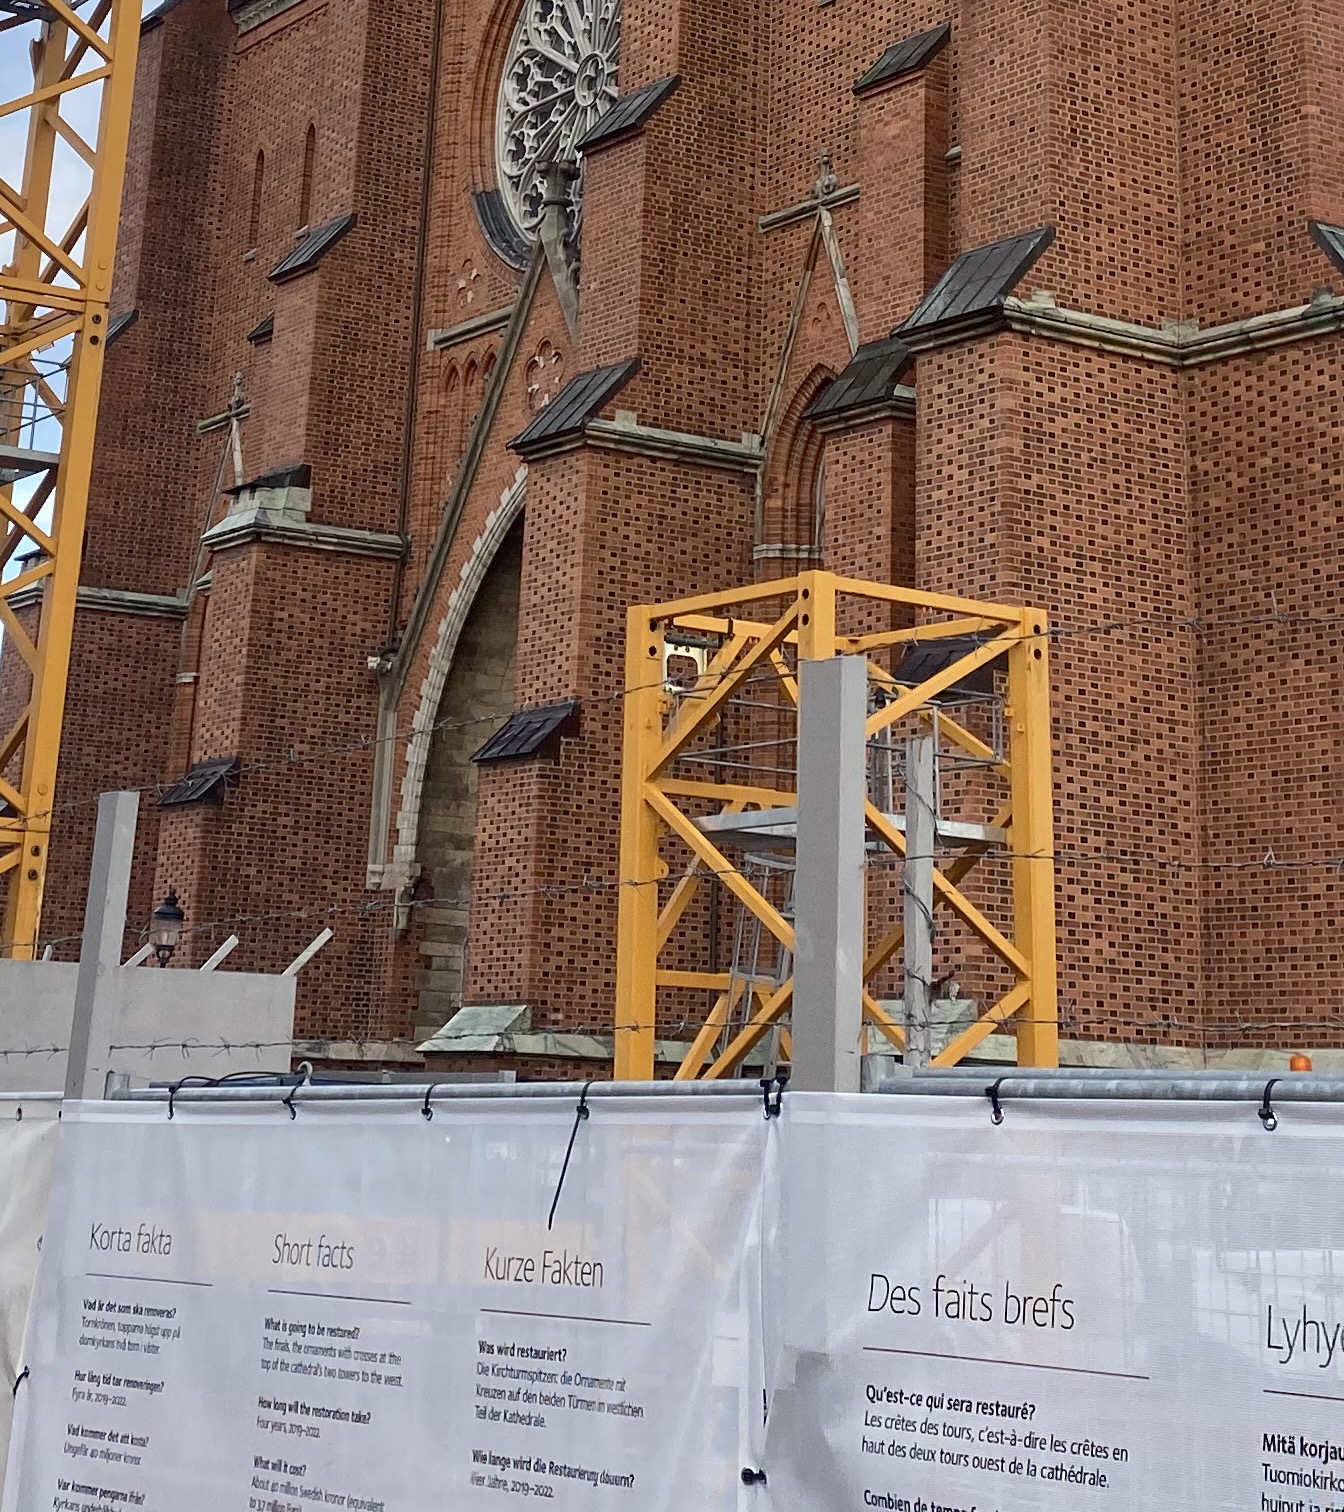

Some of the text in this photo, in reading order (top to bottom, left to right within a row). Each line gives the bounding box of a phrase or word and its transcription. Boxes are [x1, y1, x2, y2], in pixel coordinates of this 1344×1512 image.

[90, 1222, 173, 1255] Korta fakta
[272, 1233, 355, 1270] Short facts
[483, 1246, 604, 1288] Kurze Fakten
[83, 1298, 96, 1310] Vad
[106, 1300, 117, 1312] det
[117, 1304, 131, 1314] som
[132, 1302, 143, 1315] ska
[867, 1273, 1075, 1330] Des faits brefs
[264, 1318, 361, 1340] What is going to be restored?
[263, 1337, 402, 1366] The the ornaments with crosses at the
[478, 1340, 567, 1362] Was wird restauriert?
[74, 1369, 86, 1381] Hur
[102, 1373, 112, 1385] tid
[112, 1375, 123, 1386] tar
[261, 1357, 272, 1372] top
[271, 1357, 279, 1371] of
[279, 1358, 290, 1372] the
[324, 1365, 336, 1379] two
[337, 1367, 360, 1381] towers
[361, 1370, 370, 1383] to
[370, 1369, 382, 1385] the
[477, 1362, 489, 1376] Die
[560, 1370, 572, 1385] die
[258, 1395, 371, 1424] How long will the restoration take?
[476, 1384, 506, 1400] Kreuzen
[508, 1387, 521, 1402] auf
[522, 1389, 537, 1404] den
[539, 1390, 566, 1407] beiden
[568, 1394, 596, 1411] Türmen
[926, 1392, 945, 1413] qui
[946, 1398, 973, 1414] sera
[975, 1400, 1036, 1421] restauré?
[257, 1415, 271, 1429] Four
[475, 1404, 547, 1428] Teil der Kathedrale.
[67, 1423, 80, 1436] Vad
[107, 1430, 119, 1443] det
[864, 1410, 882, 1428] Les
[884, 1414, 917, 1433] crêtes
[919, 1417, 939, 1436] des
[942, 1422, 975, 1443] tours,
[1050, 1433, 1067, 1454] les
[1070, 1438, 1109, 1459] crêtes
[1112, 1447, 1128, 1462] en
[1262, 1433, 1296, 1455] Mitä
[254, 1455, 307, 1477] What will it cost?
[472, 1448, 487, 1464] Wie
[488, 1450, 511, 1471] lange
[512, 1455, 532, 1471] wird
[533, 1458, 546, 1473] die
[549, 1461, 599, 1487] Restaurierung
[861, 1435, 1110, 1489] haut des deux tours ouest de la cathédrale.
[57, 1478, 71, 1491] Var
[71, 1480, 98, 1496] kommer
[99, 1488, 128, 1504] pengarna
[251, 1475, 270, 1491] About
[280, 1481, 298, 1497] million
[299, 1485, 324, 1502] Swedish
[324, 1489, 346, 1506] kronor
[471, 1470, 486, 1486] Vier
[864, 1489, 911, 1512] Combien
[914, 1497, 928, 1512] de
